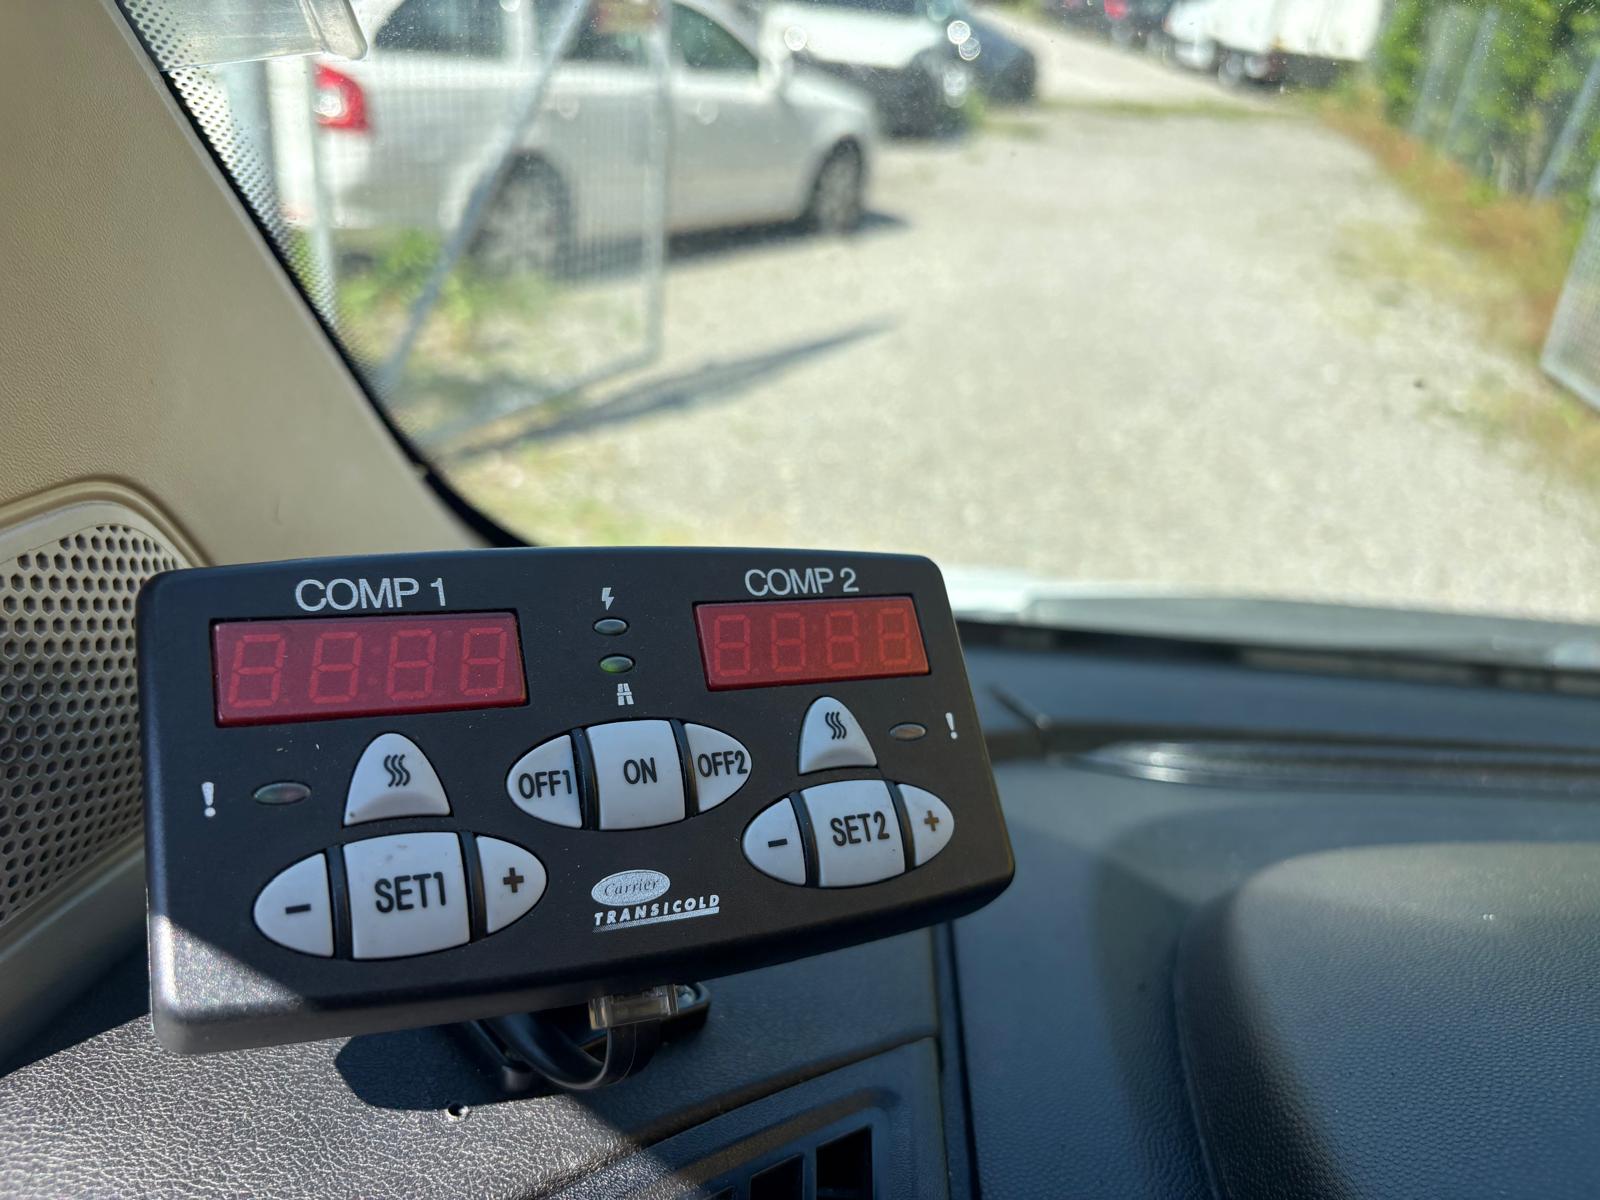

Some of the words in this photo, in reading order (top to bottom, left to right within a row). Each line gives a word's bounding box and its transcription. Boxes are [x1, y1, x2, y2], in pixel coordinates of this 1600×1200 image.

[295, 577, 419, 612] COMP
[430, 577, 446, 607] 1
[745, 568, 834, 596] COMP
[840, 567, 859, 593] 2
[623, 757, 657, 784] ON
[698, 750, 748, 778] OFF2
[518, 770, 572, 799] OFF1
[830, 811, 889, 846] SET2
[375, 872, 447, 913] SET1
[604, 879, 659, 896] Carrier
[594, 894, 720, 926] TRANSICOLD
